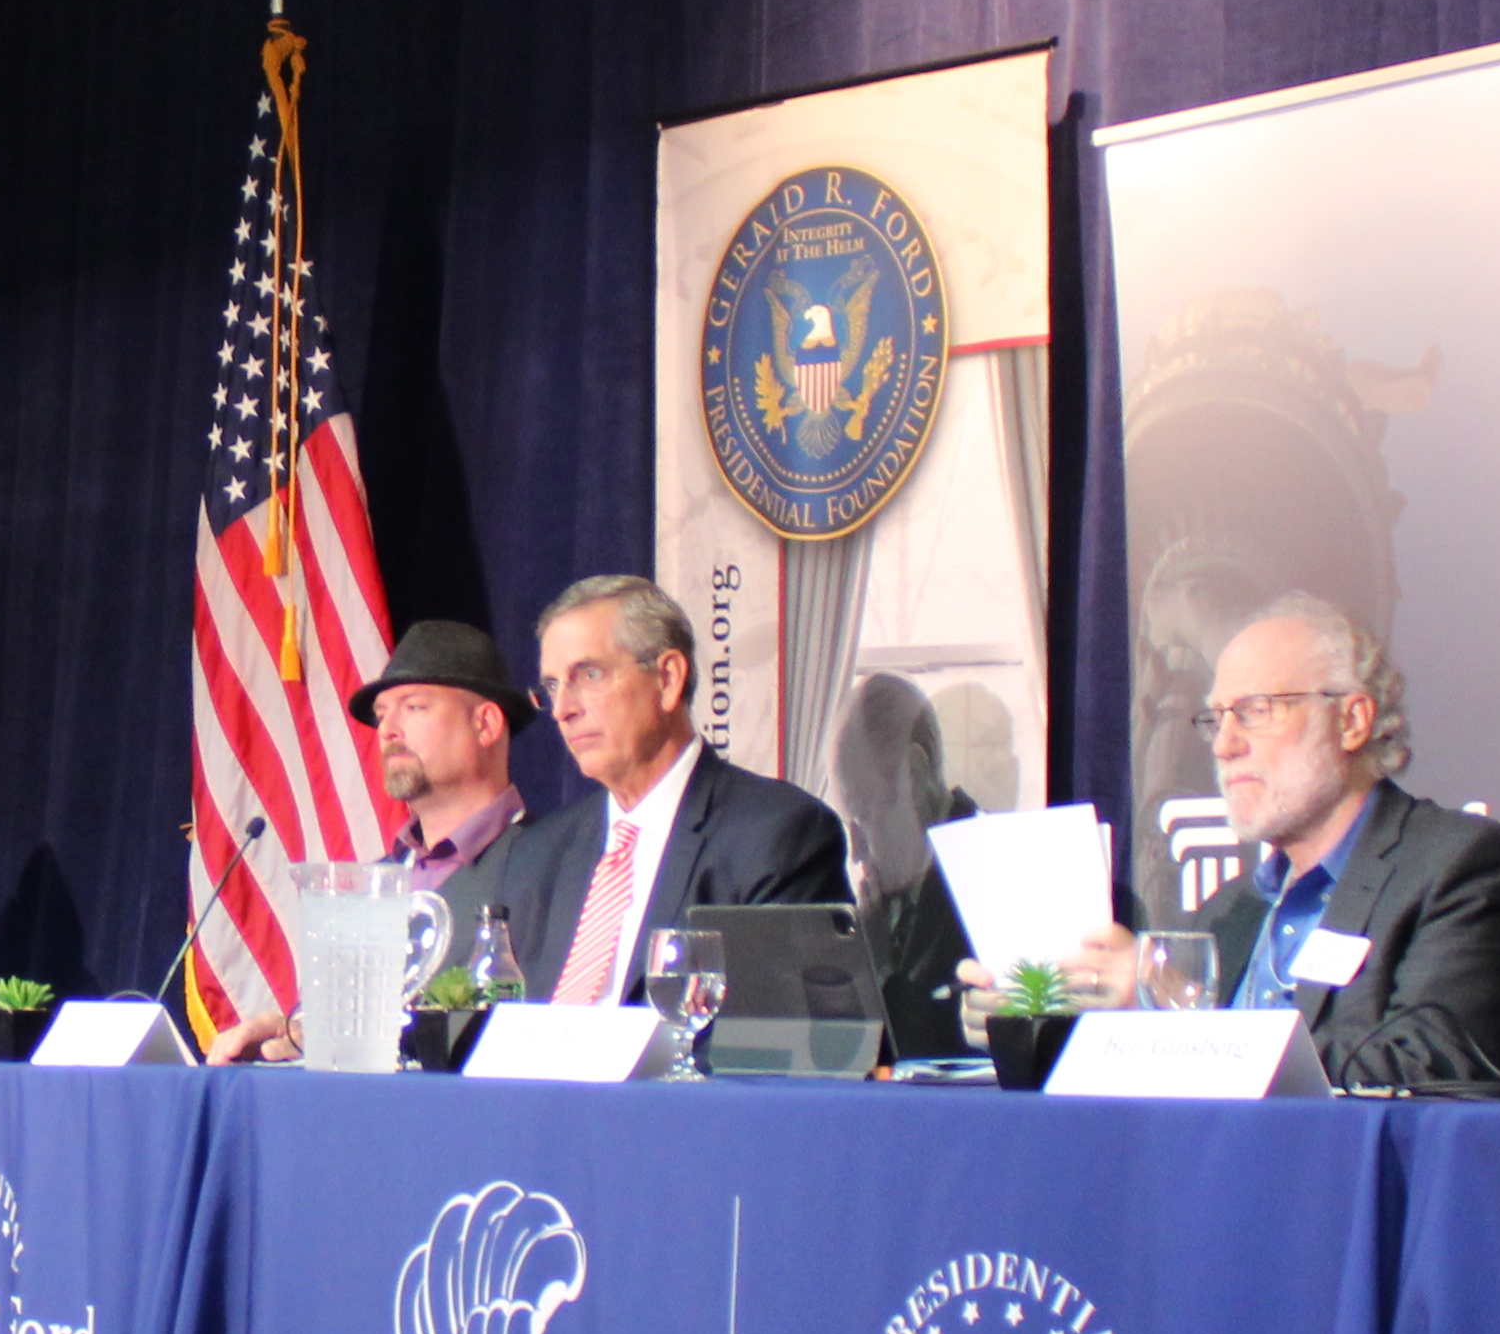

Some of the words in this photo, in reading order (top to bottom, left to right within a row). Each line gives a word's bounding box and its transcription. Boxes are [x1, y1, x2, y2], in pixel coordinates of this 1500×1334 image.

[709, 184, 805, 328] GERALD
[825, 171, 853, 204] R.
[870, 189, 932, 298] FORD
[706, 384, 816, 527] PRESIDENTIAL
[826, 354, 939, 526] FOUNDATION
[704, 564, 742, 753] tion.org
